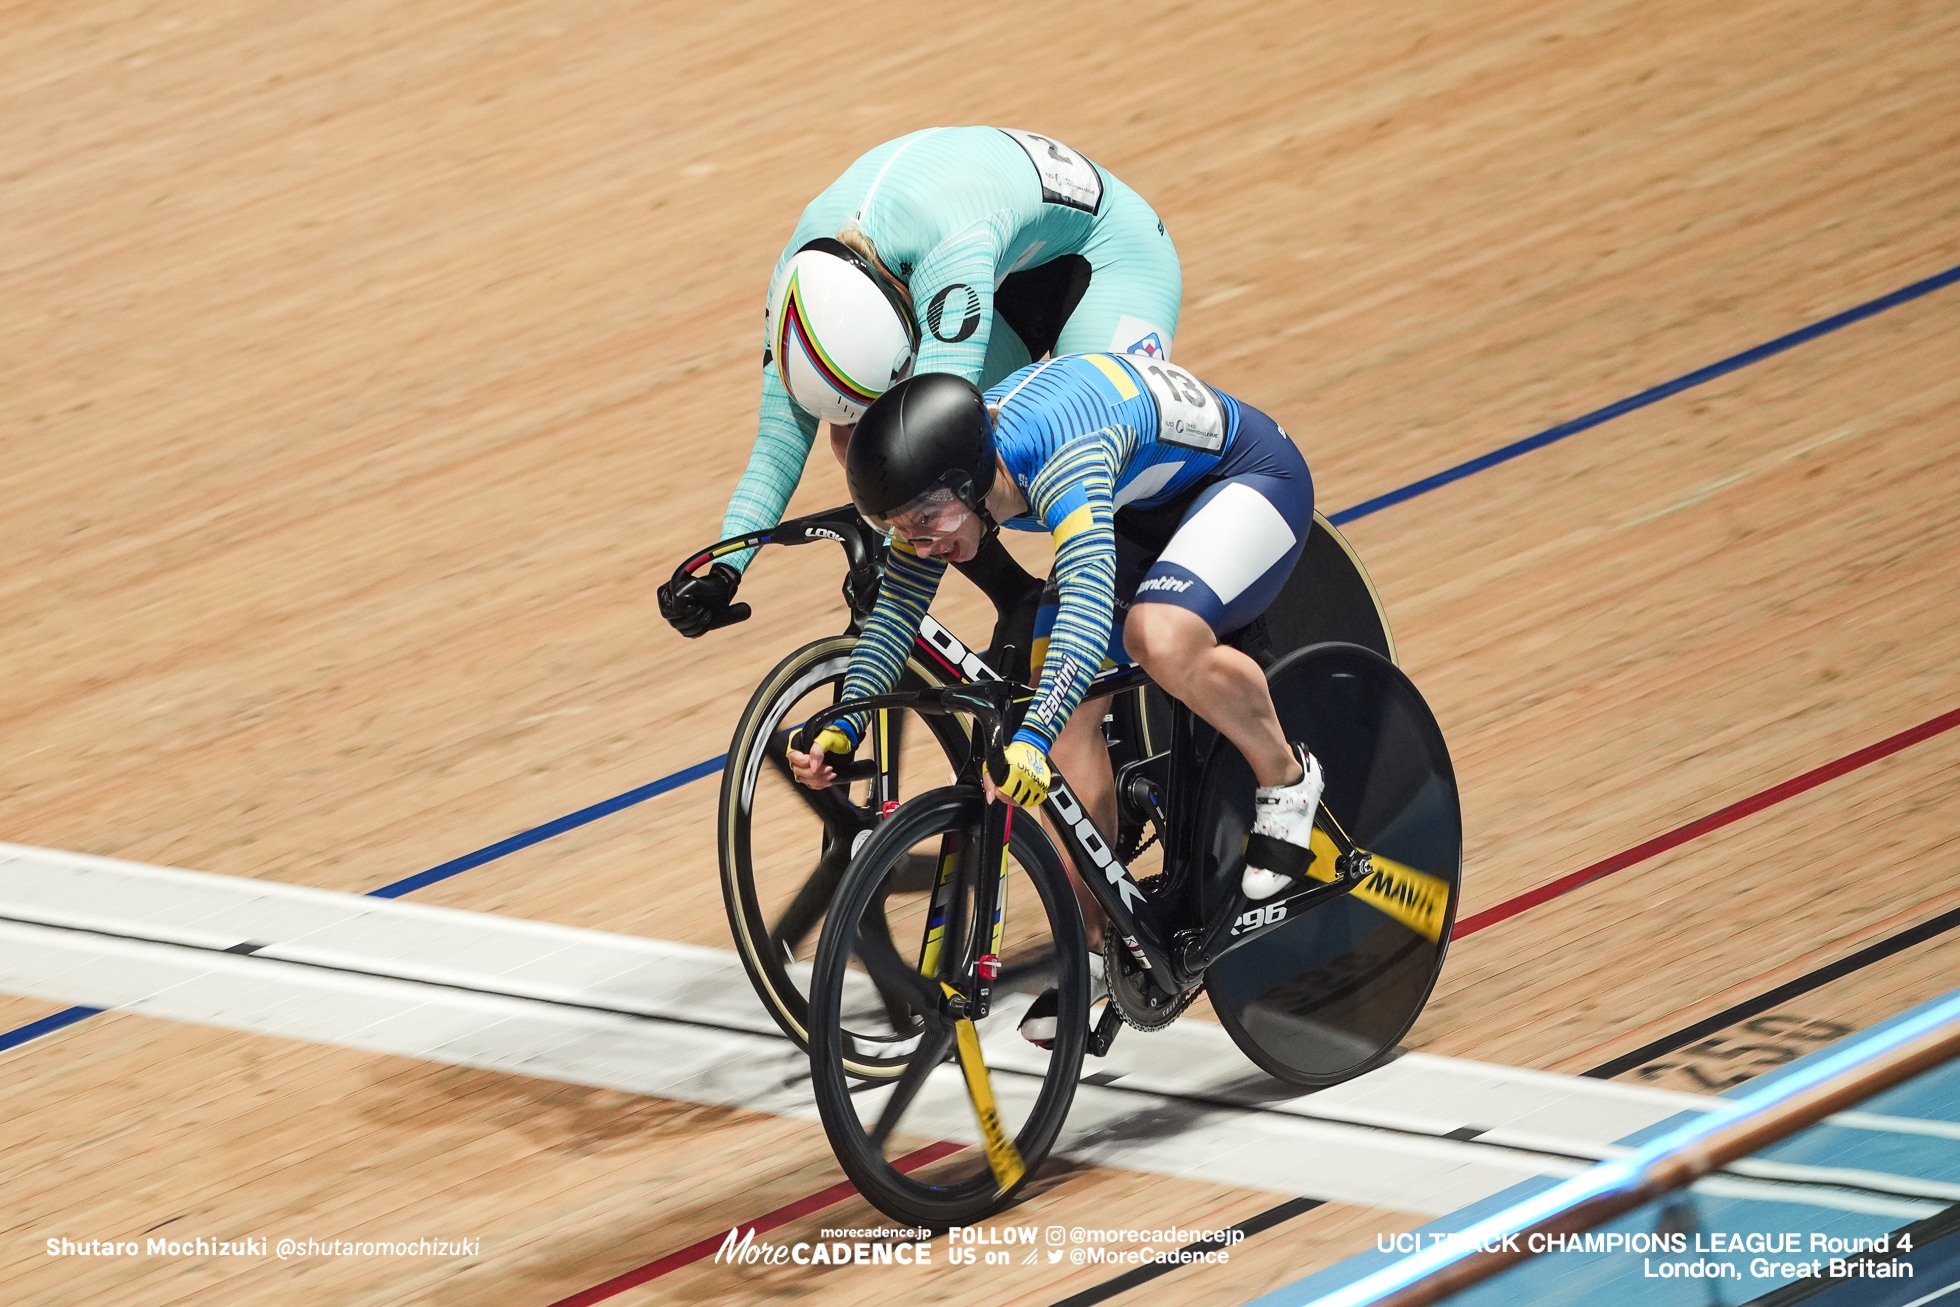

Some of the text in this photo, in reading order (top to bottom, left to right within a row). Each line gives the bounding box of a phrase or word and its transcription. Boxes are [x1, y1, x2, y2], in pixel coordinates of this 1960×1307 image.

[1148, 365, 1206, 408] 13
[804, 527, 846, 542] LOOK
[1017, 762, 1049, 795] UKRAIN
[1047, 783, 1148, 915] OOK
[1638, 1014, 1854, 1092] 250
